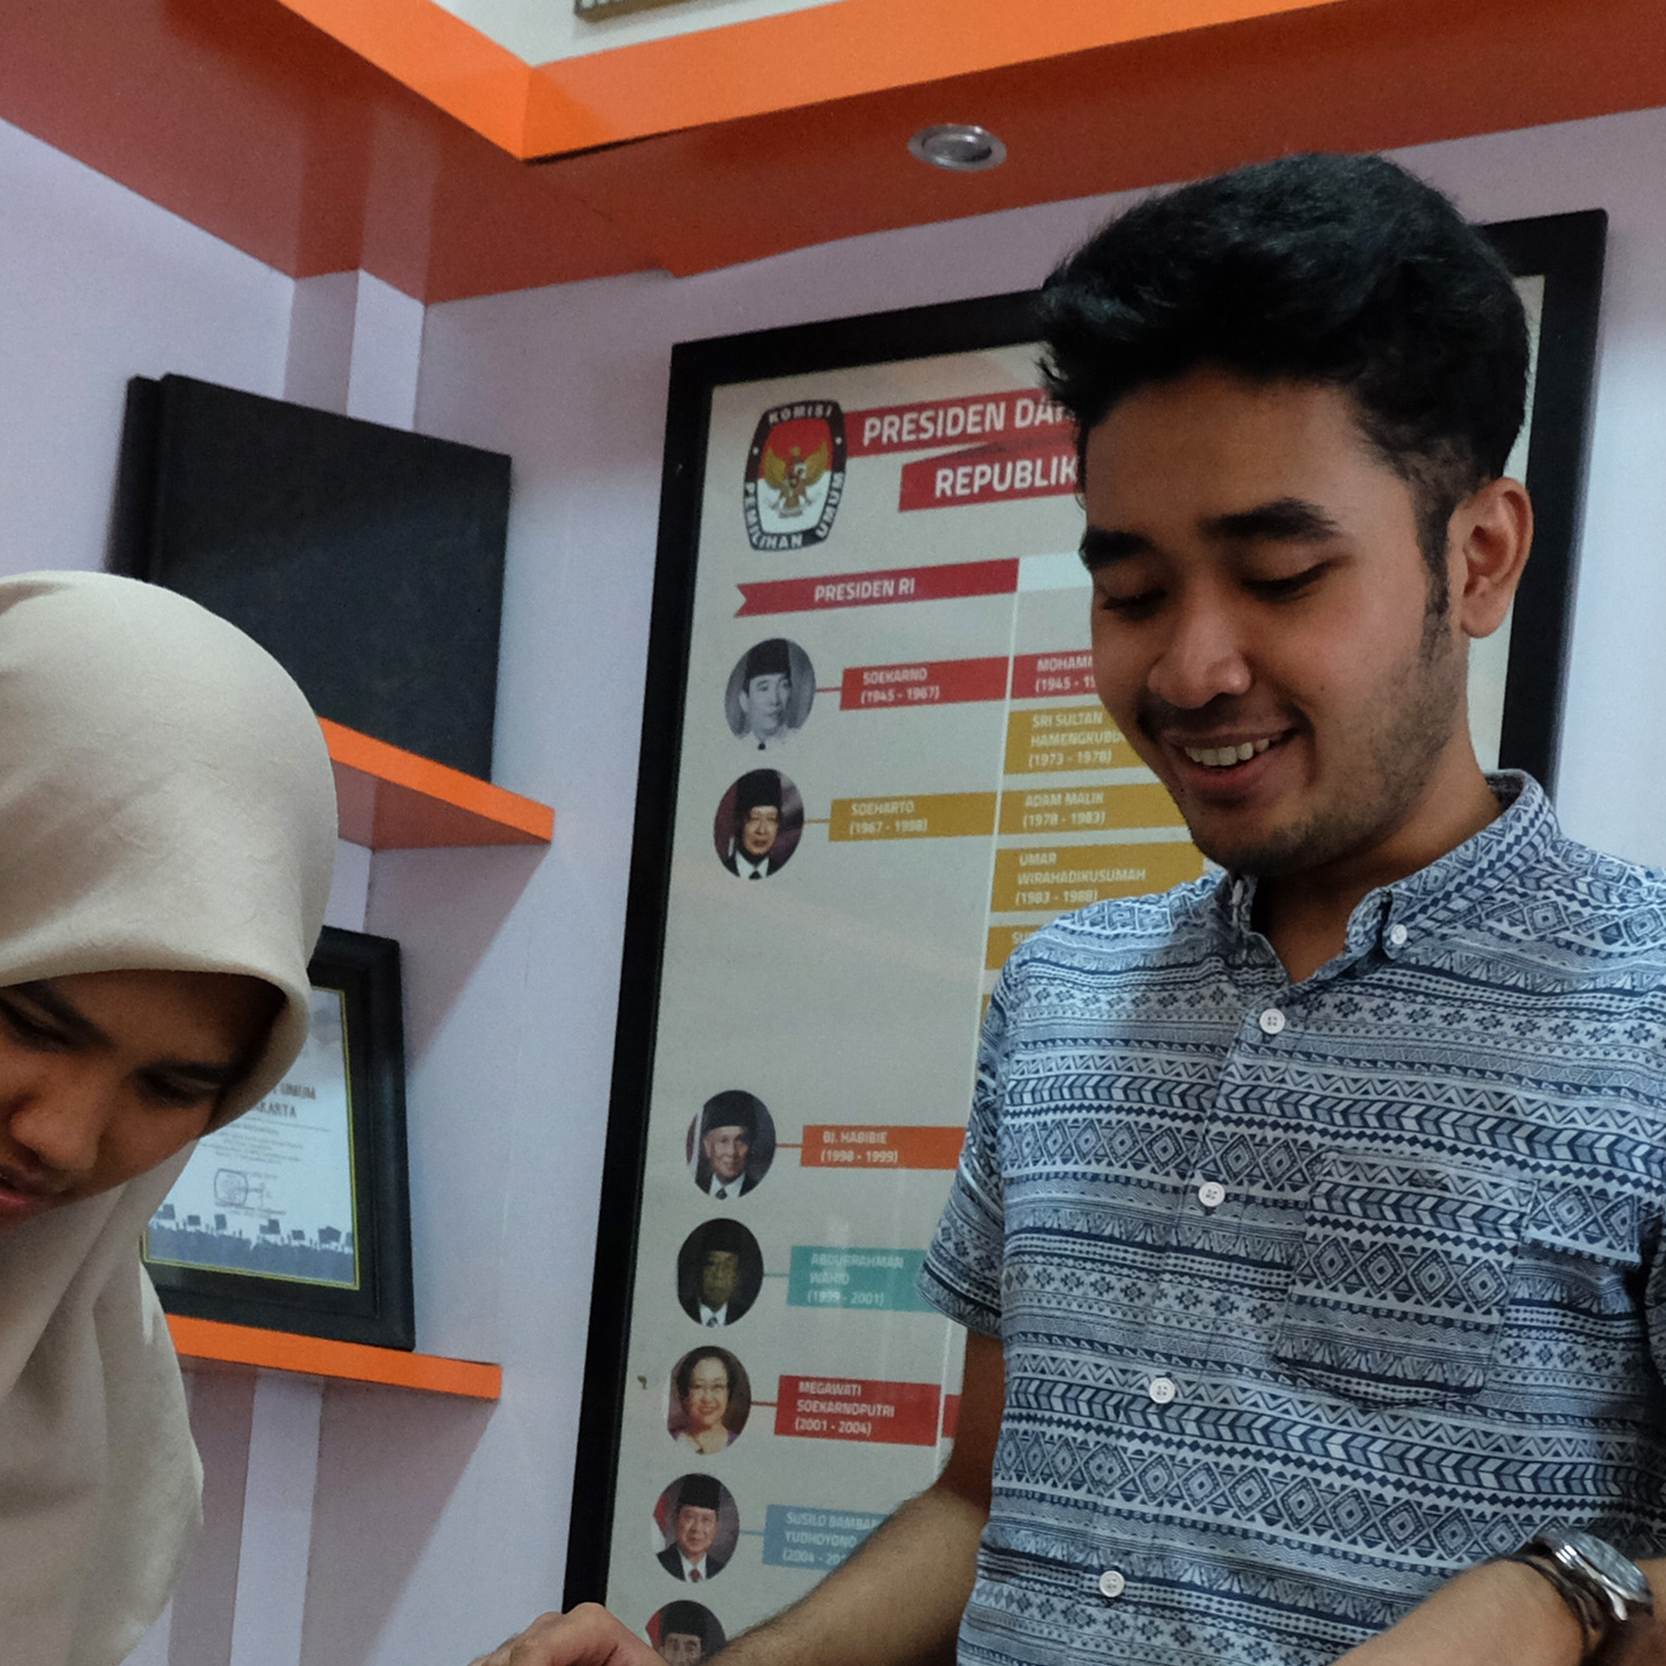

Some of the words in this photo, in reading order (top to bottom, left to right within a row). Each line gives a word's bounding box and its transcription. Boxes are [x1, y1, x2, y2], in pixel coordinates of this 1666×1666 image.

[768, 403, 833, 425] KOMISI
[863, 402, 1005, 446] PRESIDEN
[935, 455, 1078, 498] REPUBLIK
[815, 471, 845, 539] UMUM
[744, 481, 803, 549] PEMILIHAN
[814, 581, 895, 602] PRESIDEN
[898, 577, 915, 595] RI
[862, 668, 928, 685] SOEKARNO
[1032, 713, 1053, 728] SRI
[1055, 711, 1103, 727] SULTAN
[851, 799, 915, 816] SOEHARTO
[1025, 793, 1062, 809] ADAM
[1064, 791, 1104, 807] MALIK
[1019, 852, 1057, 868] UMAR
[840, 1131, 887, 1145] HABIBIE
[798, 1380, 862, 1397] MEGAWATI
[796, 1399, 895, 1418] SOEKARNOPUTRI
[795, 1417, 828, 1432] (2001
[838, 1420, 873, 1436] 2004)
